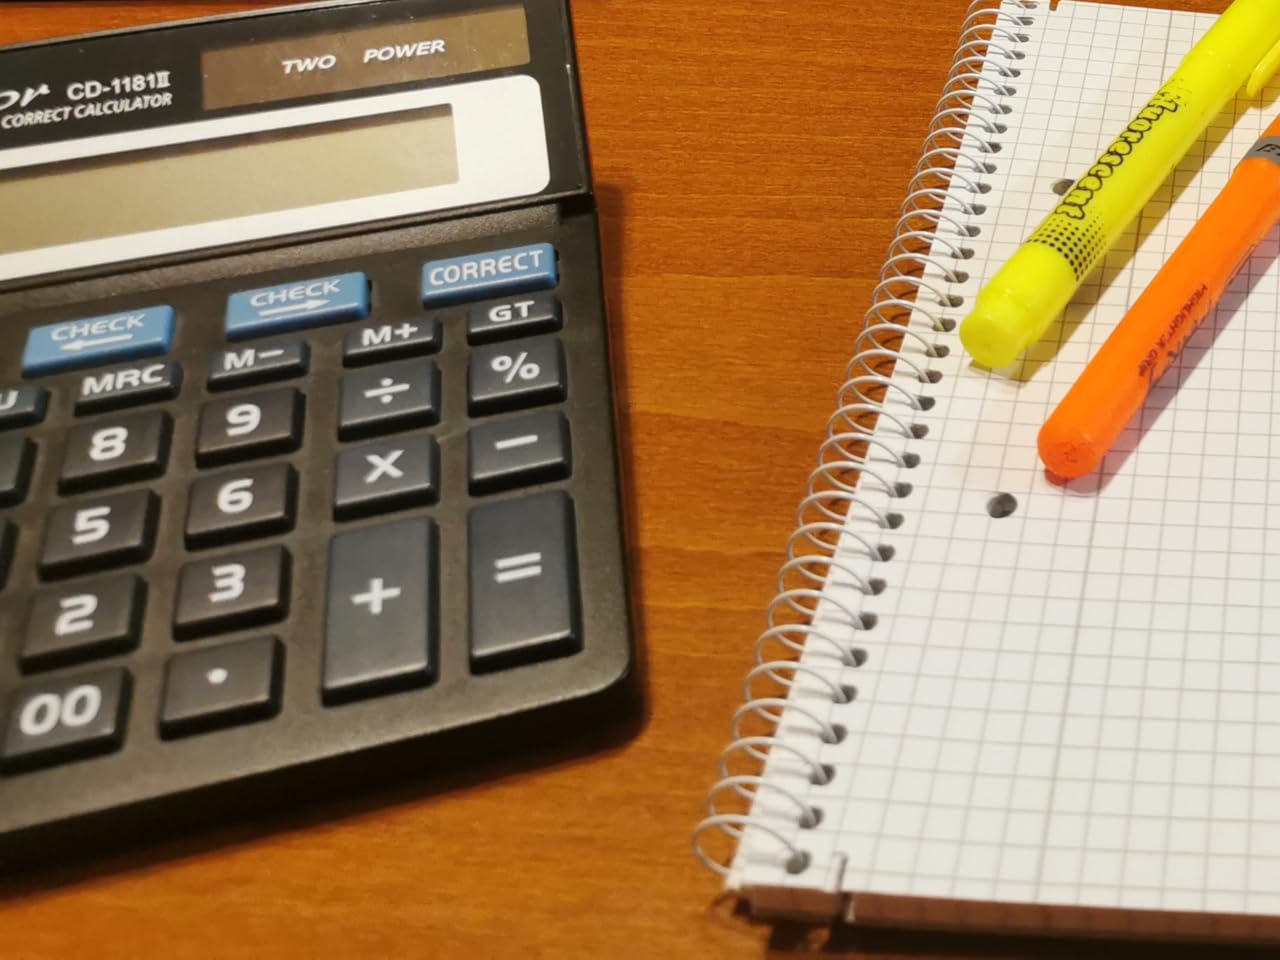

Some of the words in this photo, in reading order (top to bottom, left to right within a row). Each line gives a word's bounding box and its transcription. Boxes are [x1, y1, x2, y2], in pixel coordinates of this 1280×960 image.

[281, 54, 337, 75] TWO
[363, 39, 446, 64] POWER
[1, 106, 74, 130] CORRECT
[74, 92, 173, 120] CALCULATOR
[428, 249, 544, 286] CORRECT
[250, 279, 343, 307] CHECK
[488, 299, 535, 323] GT
[50, 313, 147, 342] CHECK
[361, 322, 419, 347] M+
[224, 348, 285, 371] M-
[491, 353, 540, 383] %
[82, 363, 165, 396] MRC
[225, 402, 262, 437] 9
[88, 425, 129, 462] 8
[216, 478, 255, 514] 6
[71, 506, 111, 545] 5
[208, 562, 246, 603] 3
[53, 592, 98, 637] 2
[18, 684, 100, 735] 00
